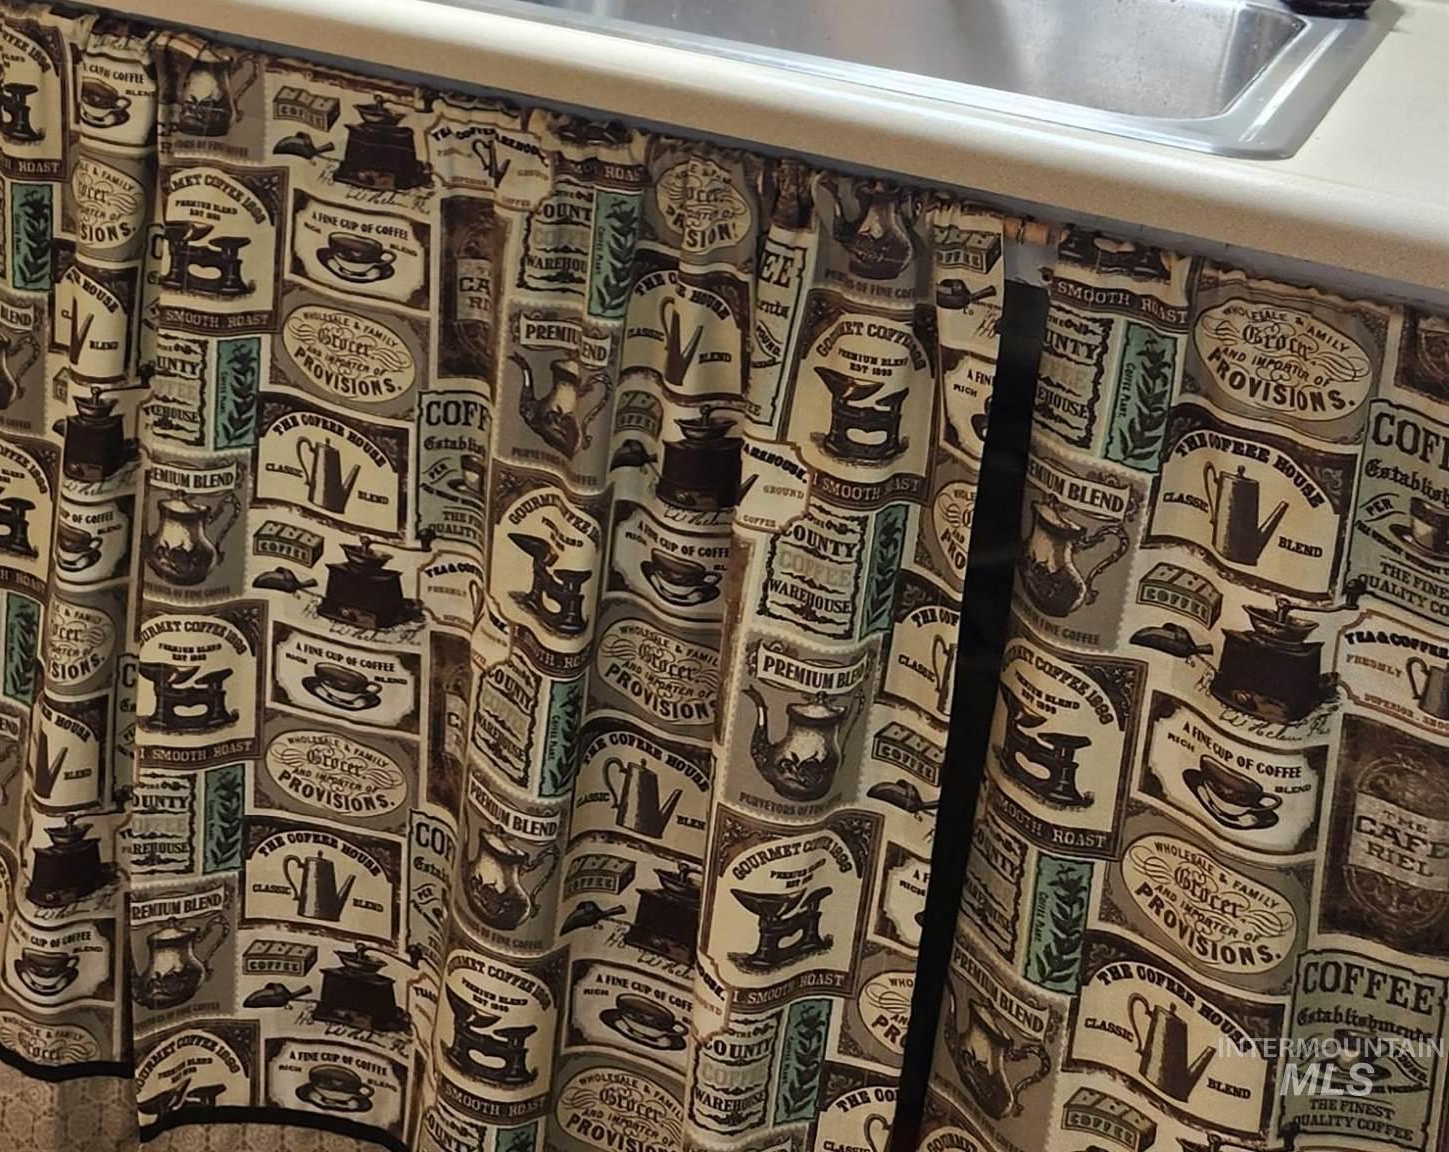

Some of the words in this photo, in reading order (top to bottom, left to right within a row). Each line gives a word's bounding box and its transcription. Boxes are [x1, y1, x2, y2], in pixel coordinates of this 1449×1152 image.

[19, 161, 60, 174] ROAST
[361, 220, 374, 233] OF
[375, 223, 409, 241] COFFEE
[82, 281, 119, 314] HOUSE
[1057, 285, 1131, 306] SMOOTH
[1, 303, 33, 326] BLEND
[166, 310, 219, 327] SMOOTH
[90, 341, 119, 350] BLEND
[363, 324, 399, 348] FAMILY
[272, 414, 300, 436] THE
[346, 428, 387, 467] HOUSE
[193, 472, 234, 489] BLEND
[1273, 455, 1325, 508] HOUSE
[357, 489, 389, 505] BLEND
[1068, 478, 1124, 512] BLEND
[1163, 491, 1209, 514] CLASSIC
[84, 511, 114, 524] COFFEE
[1278, 537, 1324, 559] BLEND
[1380, 560, 1412, 584] THE
[769, 579, 851, 614] WAREHOUSE
[1357, 573, 1427, 609] QUALITY
[359, 656, 395, 672] COFFEE
[763, 656, 834, 688] PREMIUM
[55, 715, 91, 743] HOUSE
[1167, 733, 1195, 752] RICH
[1183, 721, 1190, 734] A
[1192, 727, 1212, 748] FINE
[1213, 744, 1233, 761] CUP
[1237, 756, 1254, 771] OF
[1257, 763, 1302, 778] COFFEE
[153, 748, 207, 762] SMOOTH
[353, 748, 389, 768] FAMILY
[665, 753, 710, 792] HOUSE
[278, 769, 395, 813] PROVISIONS.
[1275, 784, 1312, 793] BLEND
[512, 813, 557, 839] BLEND
[1354, 815, 1449, 861] CAFE
[1052, 828, 1107, 849] ROAST
[258, 834, 285, 856] THE
[340, 841, 381, 877] HOUSE
[732, 842, 802, 880] GOURMET
[1365, 840, 1433, 878] RIEL
[1153, 839, 1215, 877] WHOLESALE
[1232, 880, 1280, 909] FAMILY
[184, 894, 221, 914] BLEND
[352, 898, 384, 913] BLEND
[1154, 883, 1178, 903] AND
[1179, 900, 1240, 939] IMPORTER
[1134, 880, 1282, 967] PROVISIONS.
[62, 931, 91, 944] COFFEE
[250, 960, 299, 972] COFFEE
[1097, 962, 1133, 986] THE
[596, 973, 603, 984] A
[605, 974, 629, 991] FINE
[630, 980, 652, 996] CUP
[654, 987, 669, 1001] OF
[1302, 961, 1436, 1016] COFFEE
[1000, 995, 1044, 1034] BLEND
[1084, 1018, 1133, 1042] CLASSIC
[1198, 1001, 1253, 1053] HOUSE
[289, 1049, 297, 1059] A
[297, 1050, 320, 1062] FINE
[321, 1051, 340, 1063] CUP
[341, 1054, 354, 1065] OF
[355, 1057, 389, 1076] COFFEE
[1207, 1077, 1251, 1099] BLEND
[1310, 1098, 1338, 1111] THE
[1340, 1101, 1395, 1122] FINEST
[1293, 1115, 1355, 1130] QUALITY
[1357, 1116, 1414, 1142] COFFEE
